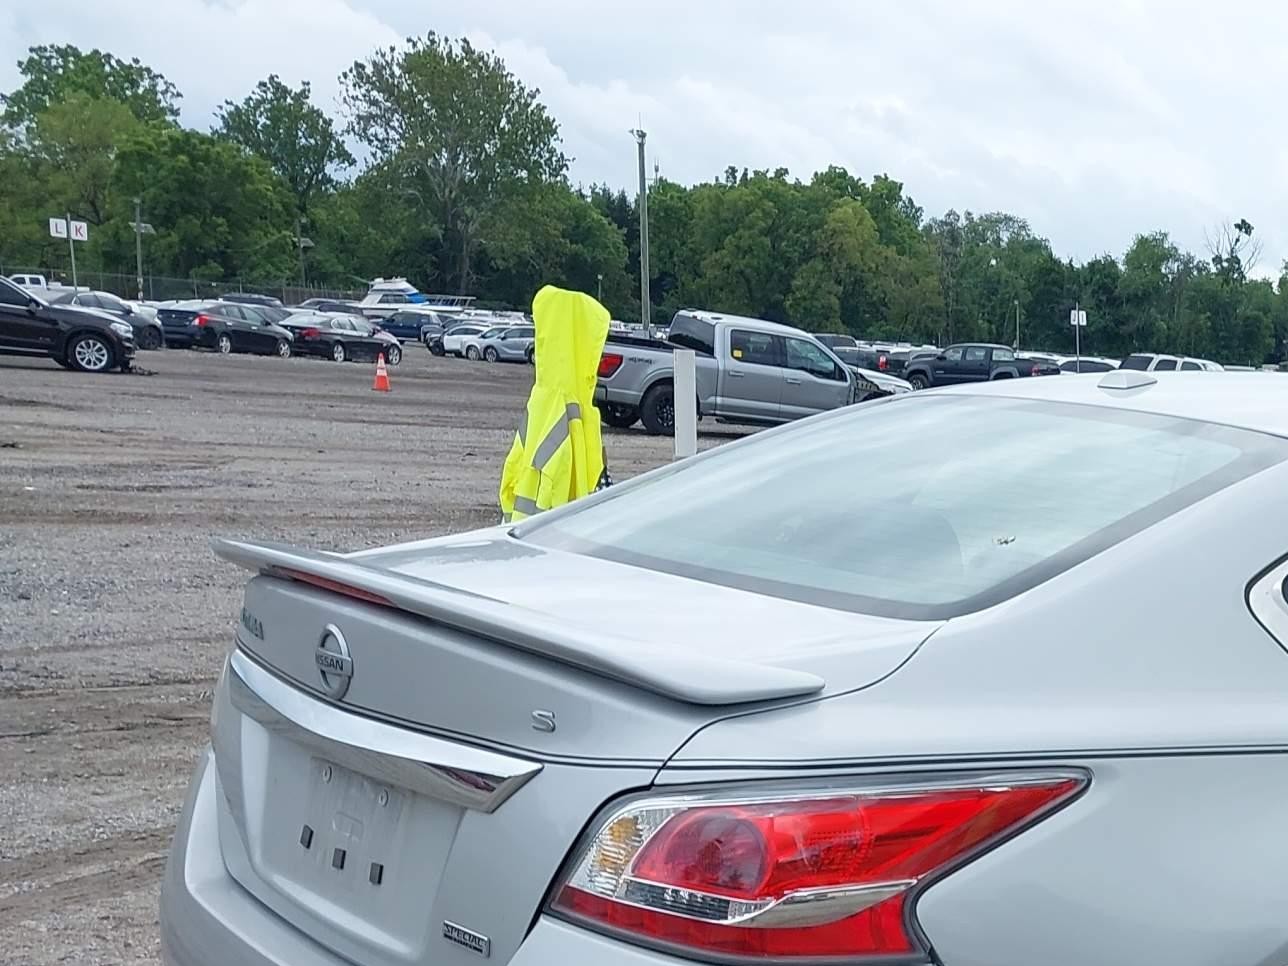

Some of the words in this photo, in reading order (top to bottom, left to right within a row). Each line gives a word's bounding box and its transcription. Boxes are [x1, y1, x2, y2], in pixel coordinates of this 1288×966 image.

[55, 223, 62, 234] L
[75, 224, 83, 237] K
[531, 710, 556, 733] S
[444, 922, 484, 948] SPECIAL
